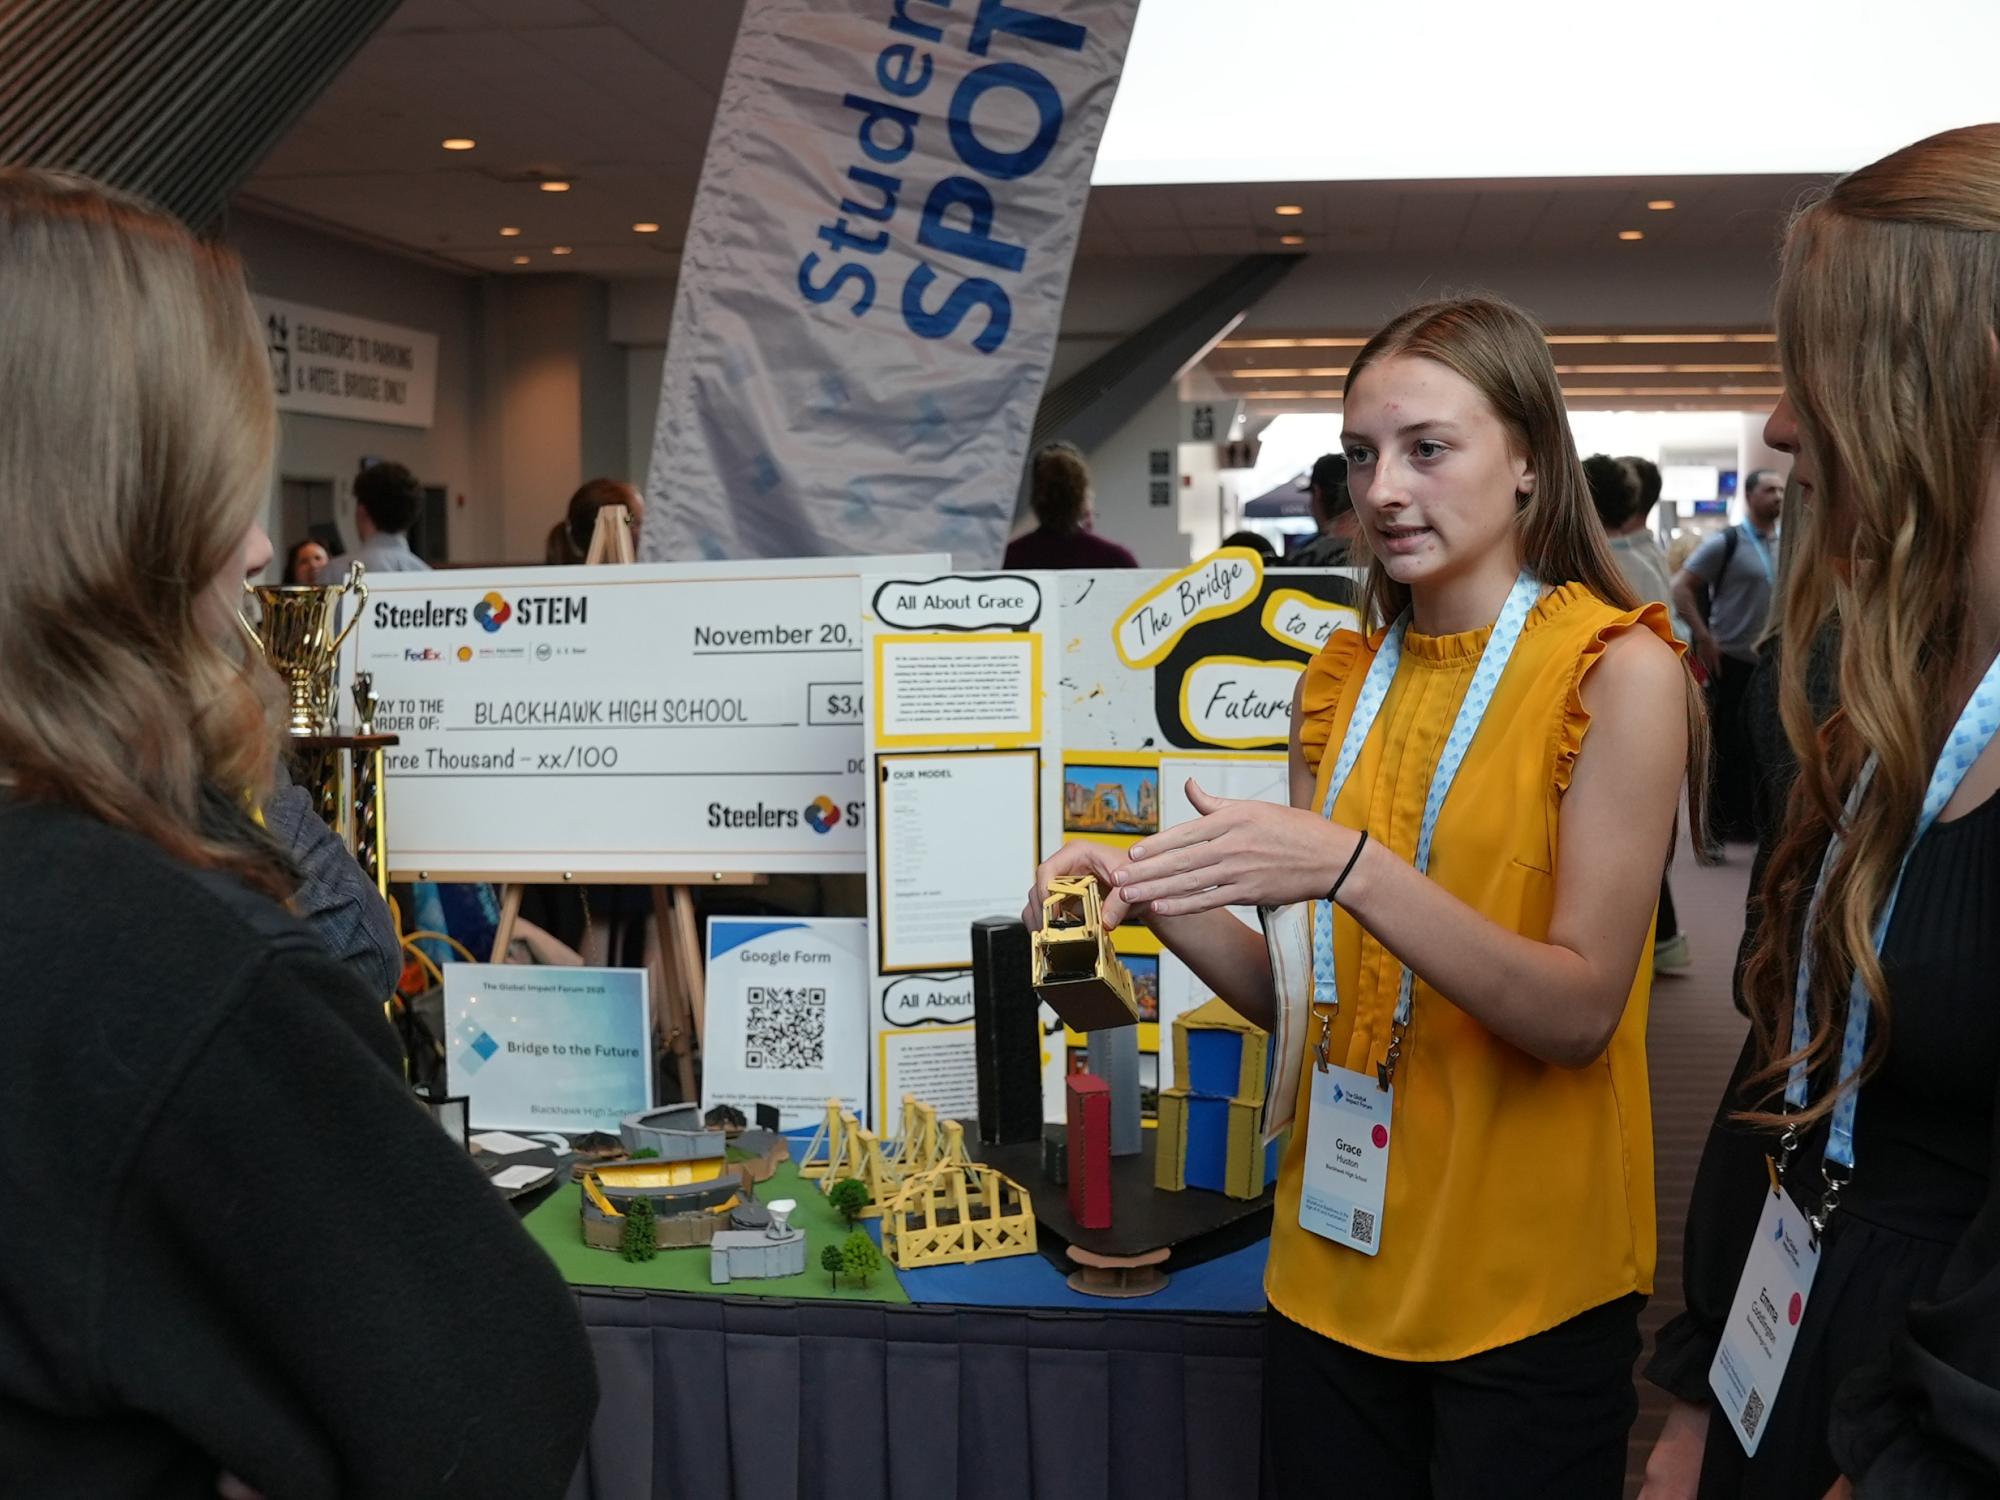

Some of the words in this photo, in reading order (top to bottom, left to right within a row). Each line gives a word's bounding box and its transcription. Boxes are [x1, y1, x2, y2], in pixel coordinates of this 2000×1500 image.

[896, 595, 916, 610] All
[923, 594, 971, 610] About
[977, 594, 1024, 609] Grace
[1132, 606, 1172, 646] The
[1176, 561, 1243, 617] Bridge
[374, 600, 467, 629] Steelers
[516, 596, 588, 625] STEM
[1286, 613, 1307, 635] to
[694, 624, 813, 647] November
[819, 623, 853, 646] 20,
[404, 647, 441, 663] FedEx
[376, 700, 396, 715] AY
[399, 700, 416, 714] TO
[419, 699, 445, 714] THE
[474, 700, 603, 725] BLACKHAWK
[608, 699, 658, 724] HIGH
[662, 698, 749, 723] SCHOOL
[418, 716, 440, 730] OF:
[425, 747, 515, 769] Thousand
[537, 745, 618, 769] xx/100
[893, 770, 915, 780] OUR
[918, 769, 953, 779] MODEL
[707, 802, 799, 829] Steelers
[740, 950, 791, 965] Google
[794, 950, 832, 963] Form
[900, 994, 919, 1008] All
[925, 992, 972, 1007] About
[507, 1041, 549, 1057] Bridge
[552, 1043, 567, 1056] to
[570, 1043, 592, 1057] the
[594, 1045, 640, 1059] Future
[1335, 1138, 1362, 1157] Grace
[1336, 1153, 1359, 1169] Huston
